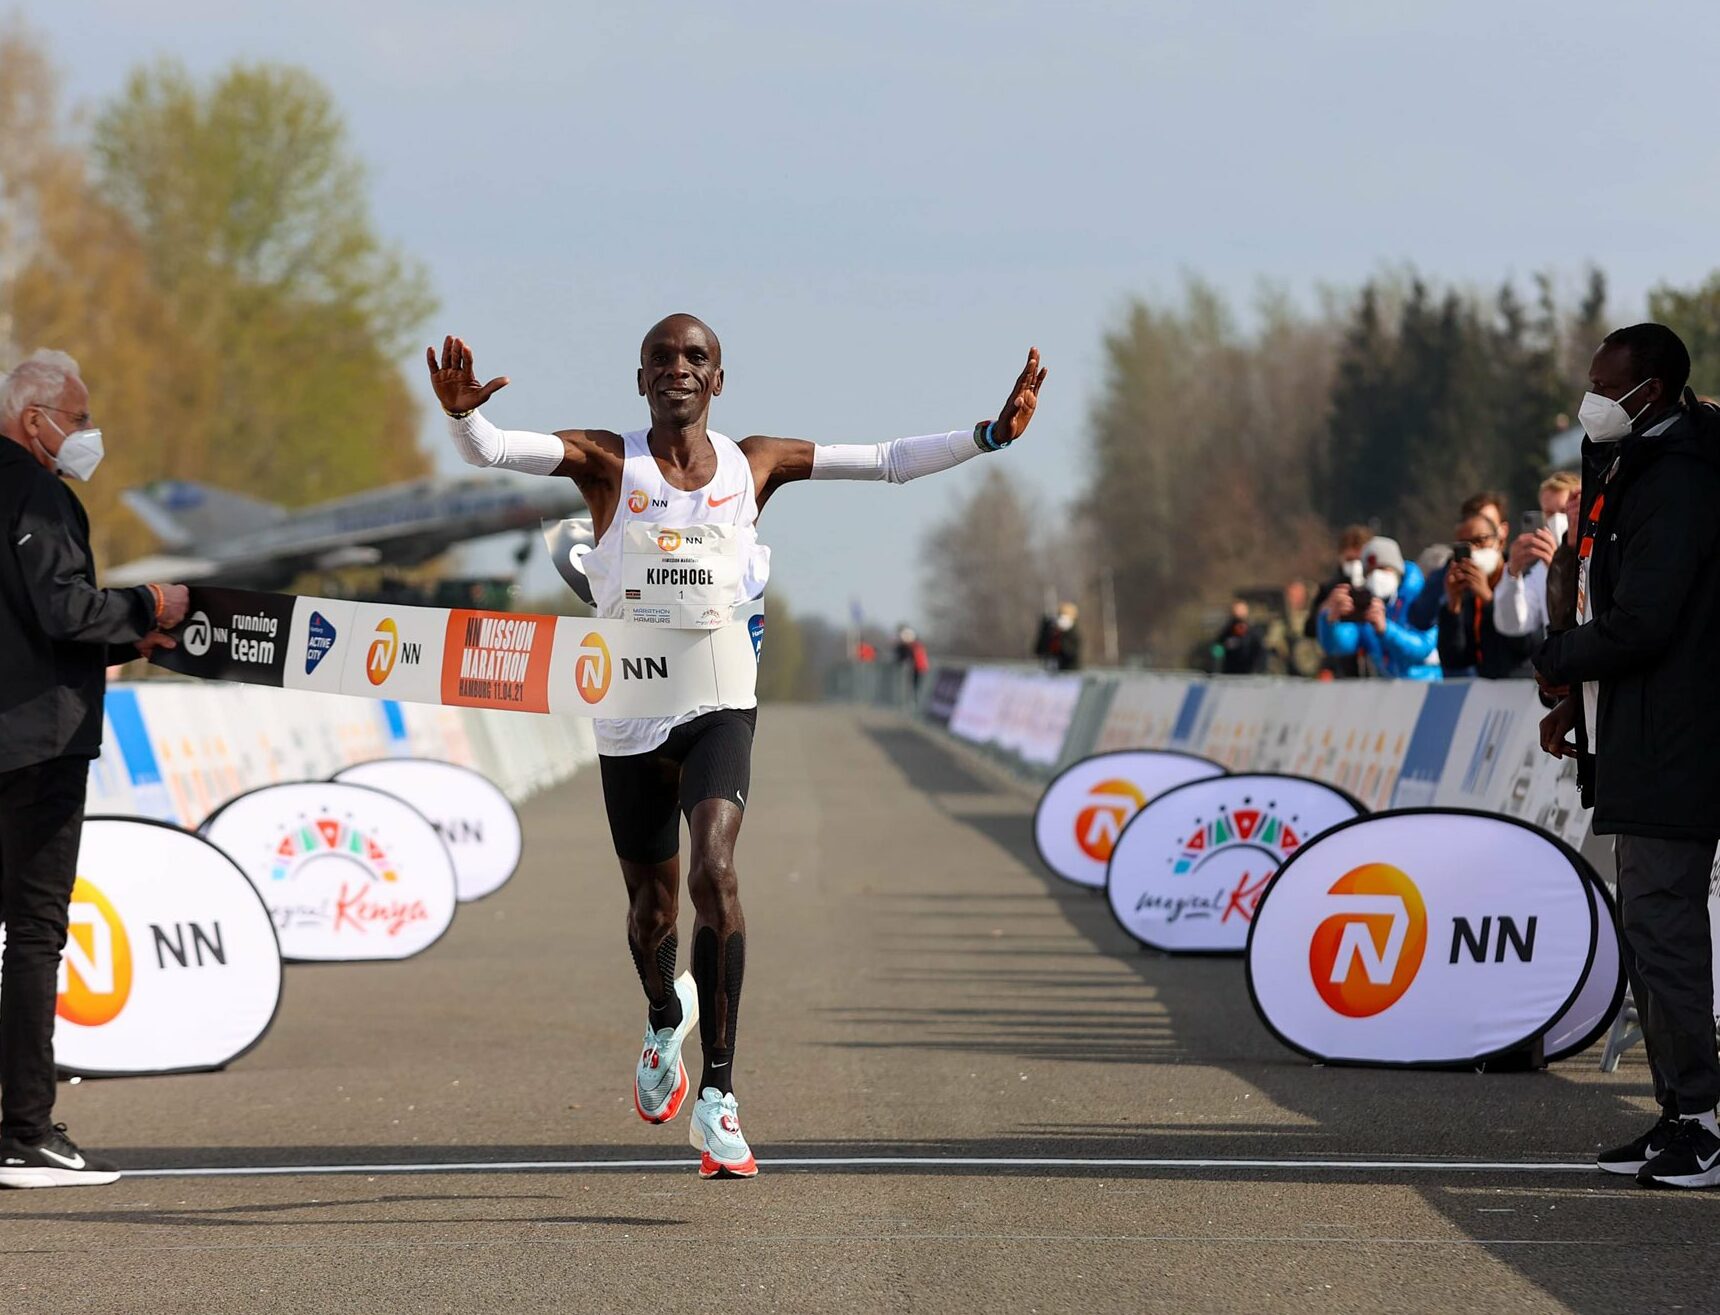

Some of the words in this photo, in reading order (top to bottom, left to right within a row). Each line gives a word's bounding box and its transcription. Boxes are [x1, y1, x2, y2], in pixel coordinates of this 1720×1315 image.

[652, 498, 668, 508] NN
[685, 536, 703, 544] NN
[647, 568, 714, 585] KIPCHOGE
[678, 590, 684, 600] 1
[632, 607, 671, 615] MARATHON
[633, 616, 671, 624] HAMBURG
[232, 611, 278, 638] running
[213, 627, 228, 643] NN
[309, 636, 332, 649] ACTIVE
[231, 632, 275, 664] team
[307, 649, 322, 660] CITY
[400, 642, 421, 664] NN
[460, 648, 530, 683] MARATHON
[621, 656, 669, 680] NN
[458, 679, 491, 699] HAMBURG
[493, 682, 524, 702] 11.04.21
[333, 881, 428, 936] Kenya
[148, 920, 228, 969] NN
[1449, 915, 1538, 965] NN
